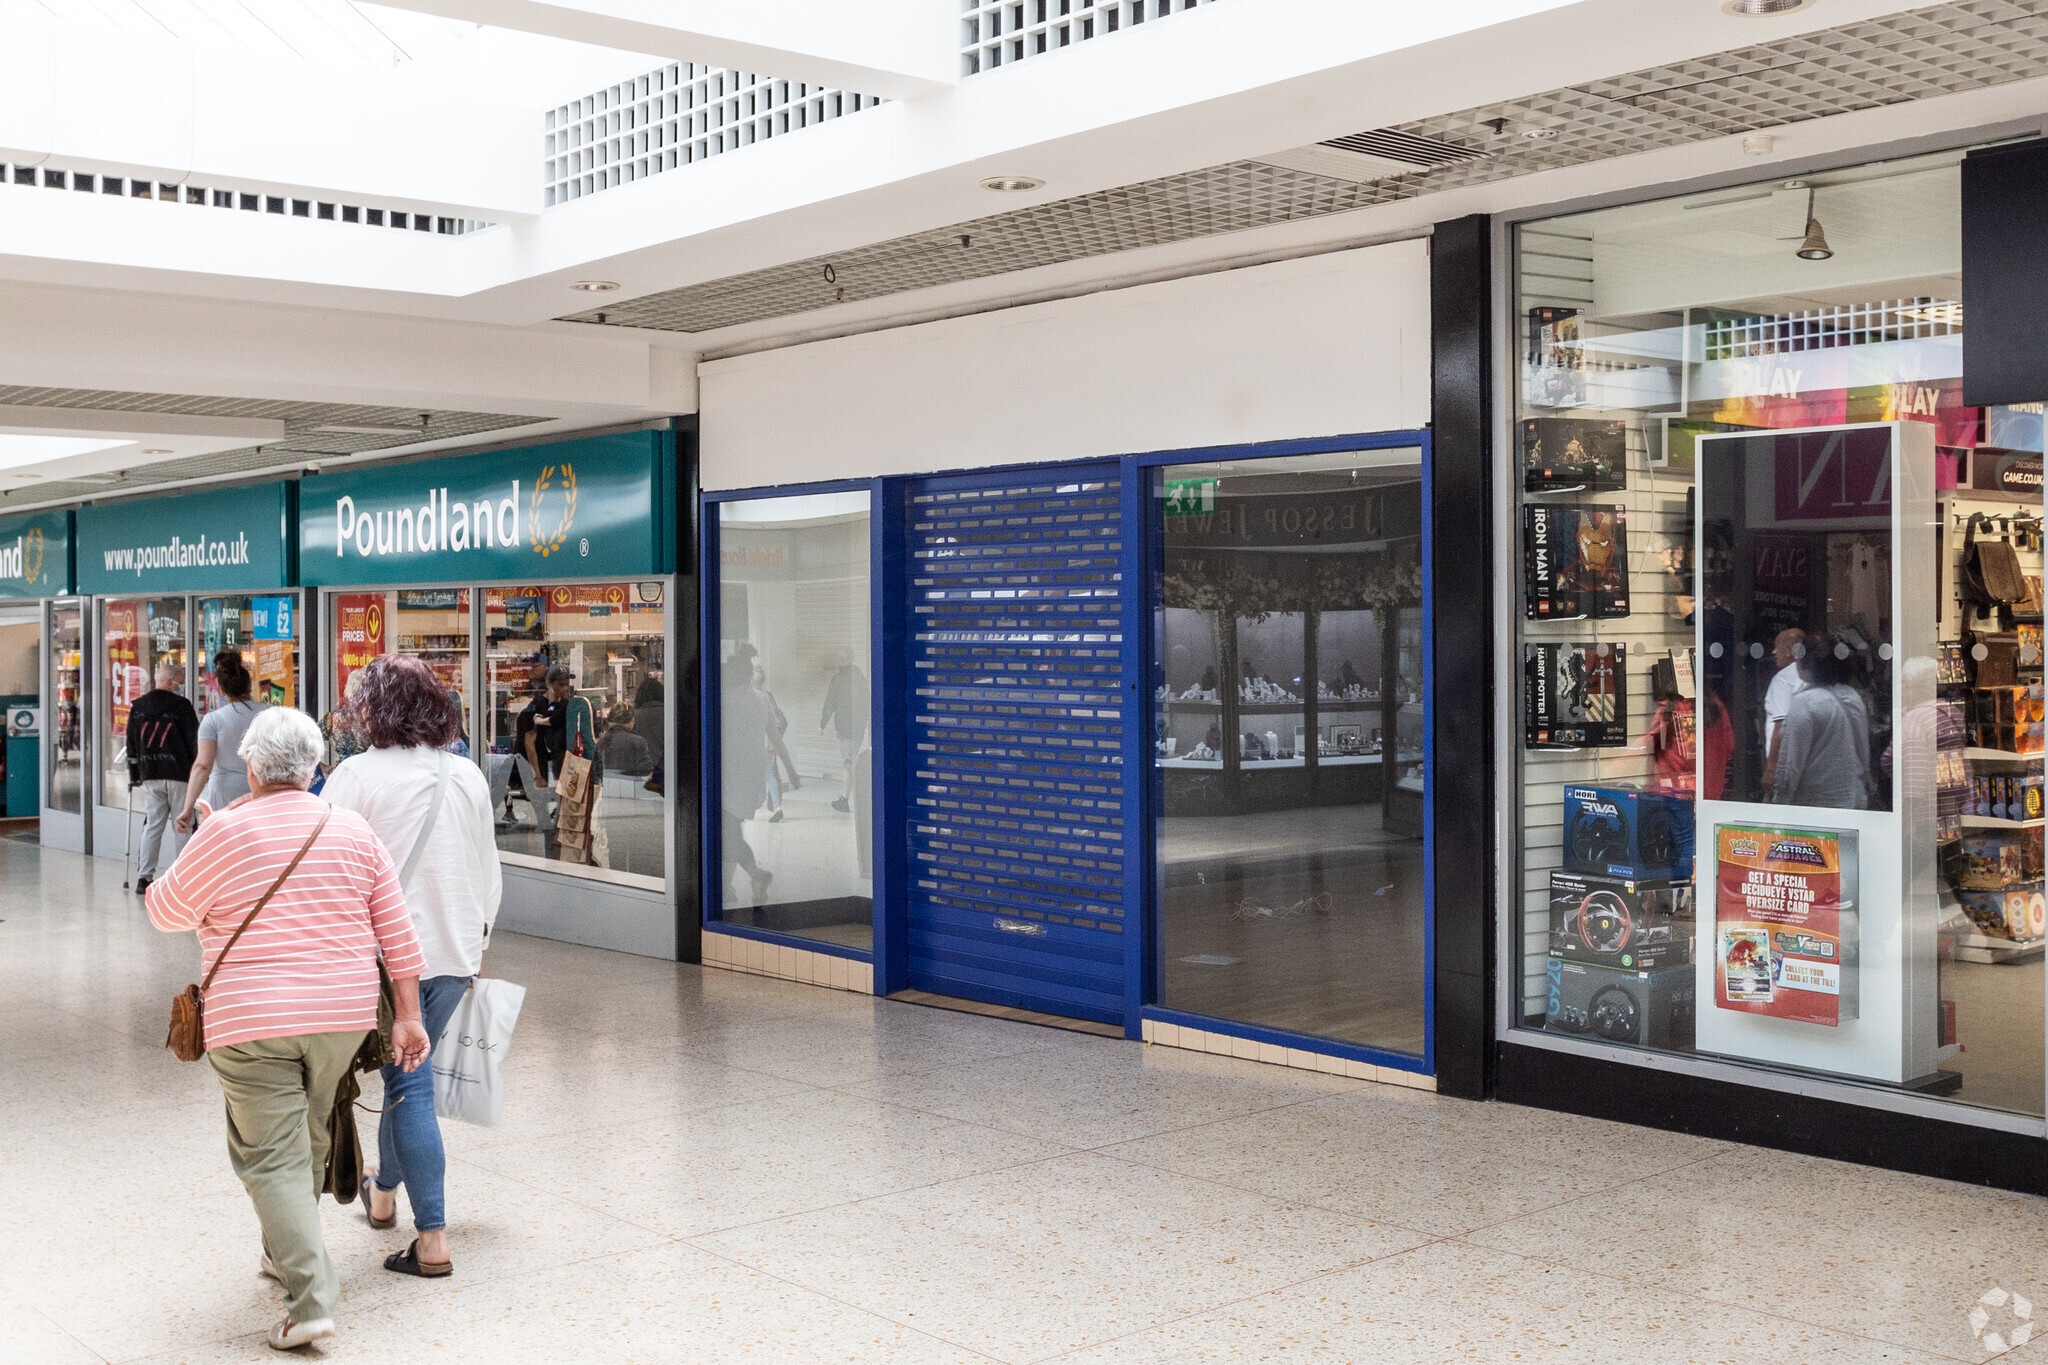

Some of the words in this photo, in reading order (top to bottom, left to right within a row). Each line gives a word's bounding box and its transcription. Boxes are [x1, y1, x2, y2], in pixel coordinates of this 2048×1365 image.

[1736, 366, 1802, 399] PLAY
[1891, 383, 1940, 416] PLAY
[336, 480, 520, 557] Poundland
[1534, 508, 1547, 544] IRON
[104, 531, 249, 577] www.poundland.co.uk
[1536, 548, 1549, 580] MAN
[575, 587, 602, 600] LOW
[277, 612, 289, 634] £2
[342, 607, 365, 630] LOW
[342, 630, 364, 642] PRICES
[1537, 647, 1545, 680] HARRY
[112, 661, 130, 705] £1
[1537, 680, 1545, 714] POTTER
[1575, 790, 1595, 799] HORI
[1581, 801, 1618, 815] RWA
[1776, 845, 1816, 855] ASTRAL
[1749, 871, 1764, 884] GET
[1766, 873, 1772, 885] A
[1773, 874, 1808, 889] SPECIAL
[1741, 883, 1786, 899] DECIDUEYE
[1788, 887, 1815, 902] VSTAR
[1746, 895, 1785, 911] OVERSIZE
[1787, 901, 1809, 914] CARD
[1785, 965, 1808, 974] COLLECT
[1809, 968, 1824, 977] YOUR
[1787, 973, 1801, 983] CARD
[1810, 976, 1821, 985] THE
[1822, 978, 1835, 987] TILL!
[1547, 957, 1562, 1017] G920
